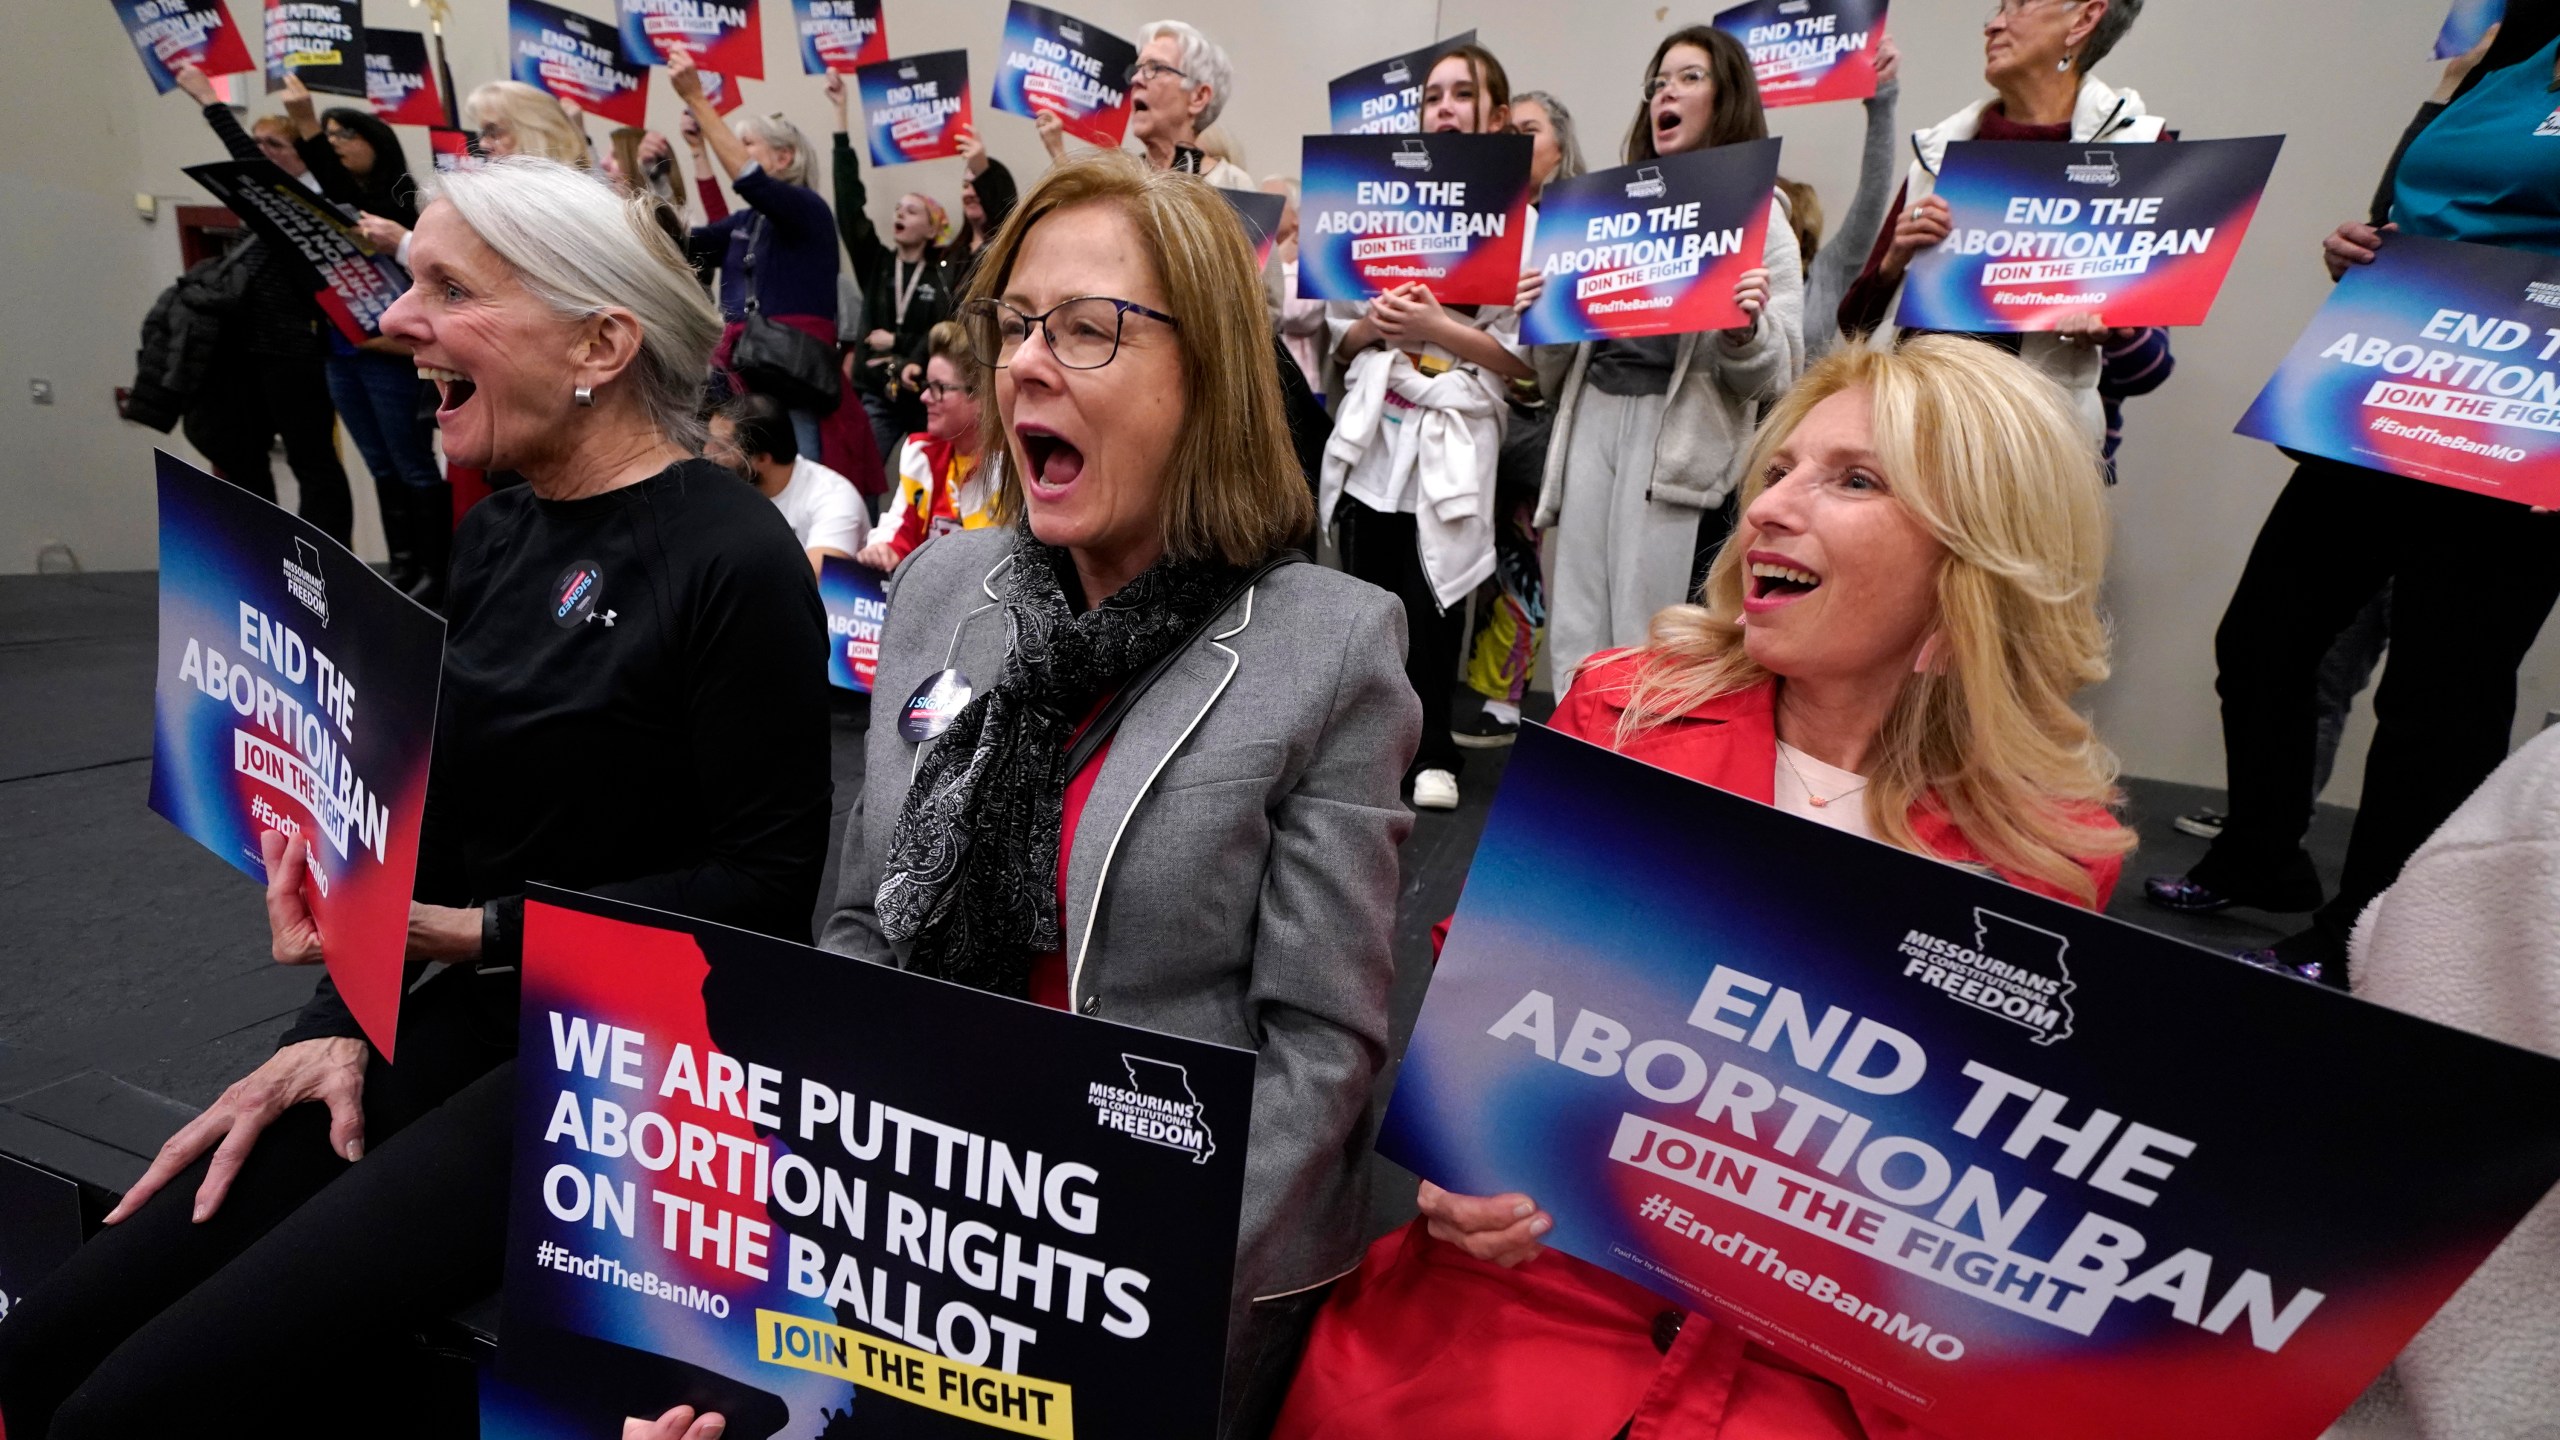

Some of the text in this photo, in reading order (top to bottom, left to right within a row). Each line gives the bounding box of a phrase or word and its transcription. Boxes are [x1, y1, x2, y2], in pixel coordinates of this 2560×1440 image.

[702, 2, 747, 28] BAN
[1748, 14, 1838, 45] END THE
[1033, 36, 1104, 78] END THE
[1820, 31, 1868, 53] BAN
[912, 81, 939, 98] THE
[1006, 51, 1087, 93] ABORTION
[1086, 80, 1124, 110] BAN
[872, 96, 961, 126] ABORTION BAN
[1361, 84, 1424, 120] END TH
[1357, 180, 1466, 207] END THE
[2004, 196, 2164, 226] END THE
[1315, 209, 1506, 239] ABORTION BAN
[1586, 202, 1701, 243] END THE
[1938, 226, 2215, 259] ABORTION BAN
[1358, 235, 1461, 257] JOIN THE FIGHT
[1542, 227, 1744, 278] ABORTION BAN
[309, 234, 382, 321] BORTION
[1364, 265, 1446, 279] #EndTheBanMO
[1582, 258, 1693, 296] JOIN THE FIGHT
[1988, 255, 2141, 284] JOIN THE FIGHT
[1587, 297, 1674, 314] #EndTheBanMO
[1993, 291, 2107, 305] #EndTheBanMO
[2419, 308, 2531, 353] END
[2320, 332, 2560, 406] ABORTION
[2374, 385, 2438, 410] JOIN
[2444, 395, 2494, 418] THE
[2370, 415, 2527, 464] #EndTheBanMO
[283, 557, 322, 592] MISSOURIANS
[590, 569, 598, 578] I
[287, 578, 326, 616] FREEDOM
[558, 576, 592, 618] SIGNED
[828, 614, 883, 642] ABORT
[852, 645, 873, 655] JOIN
[239, 600, 356, 744] END THE
[178, 637, 390, 865] ABORTION BAN
[243, 741, 345, 844] JOIN THE FIGHT
[1898, 943, 2050, 1007] FOR CONSTITUTIONAL
[1904, 929, 2062, 996] MISSOURIANS
[1903, 957, 2062, 1031] FREEDOM
[1089, 1082, 1194, 1119] MISSOURIANS
[1687, 964, 2198, 1208] END THE
[549, 1011, 1101, 1235] WE ARE PUTTING
[1088, 1095, 1193, 1129] FOR CONSTITUTIONAL
[1098, 1108, 1203, 1149] FREEDOM
[1486, 989, 2328, 1355] ABORTION BAN
[544, 1090, 1153, 1339] ABORTION RIGHTS
[1630, 1127, 2086, 1316] JOIN THE FIGHT
[536, 1239, 731, 1321] #EndTheBanMO
[541, 1163, 1037, 1376] ON THE BALLOT
[1638, 1193, 1966, 1364] #EndTheBanMO
[1613, 1246, 1631, 1259] Paid
[1630, 1253, 1643, 1265] for
[1644, 1258, 1655, 1271] by
[1654, 1263, 1702, 1295] Missourians
[1700, 1286, 1715, 1301] for
[1714, 1294, 1772, 1329] Constitutional
[1809, 1340, 1844, 1363] Michael
[771, 1321, 1056, 1428] JOIN THE FIGHT
